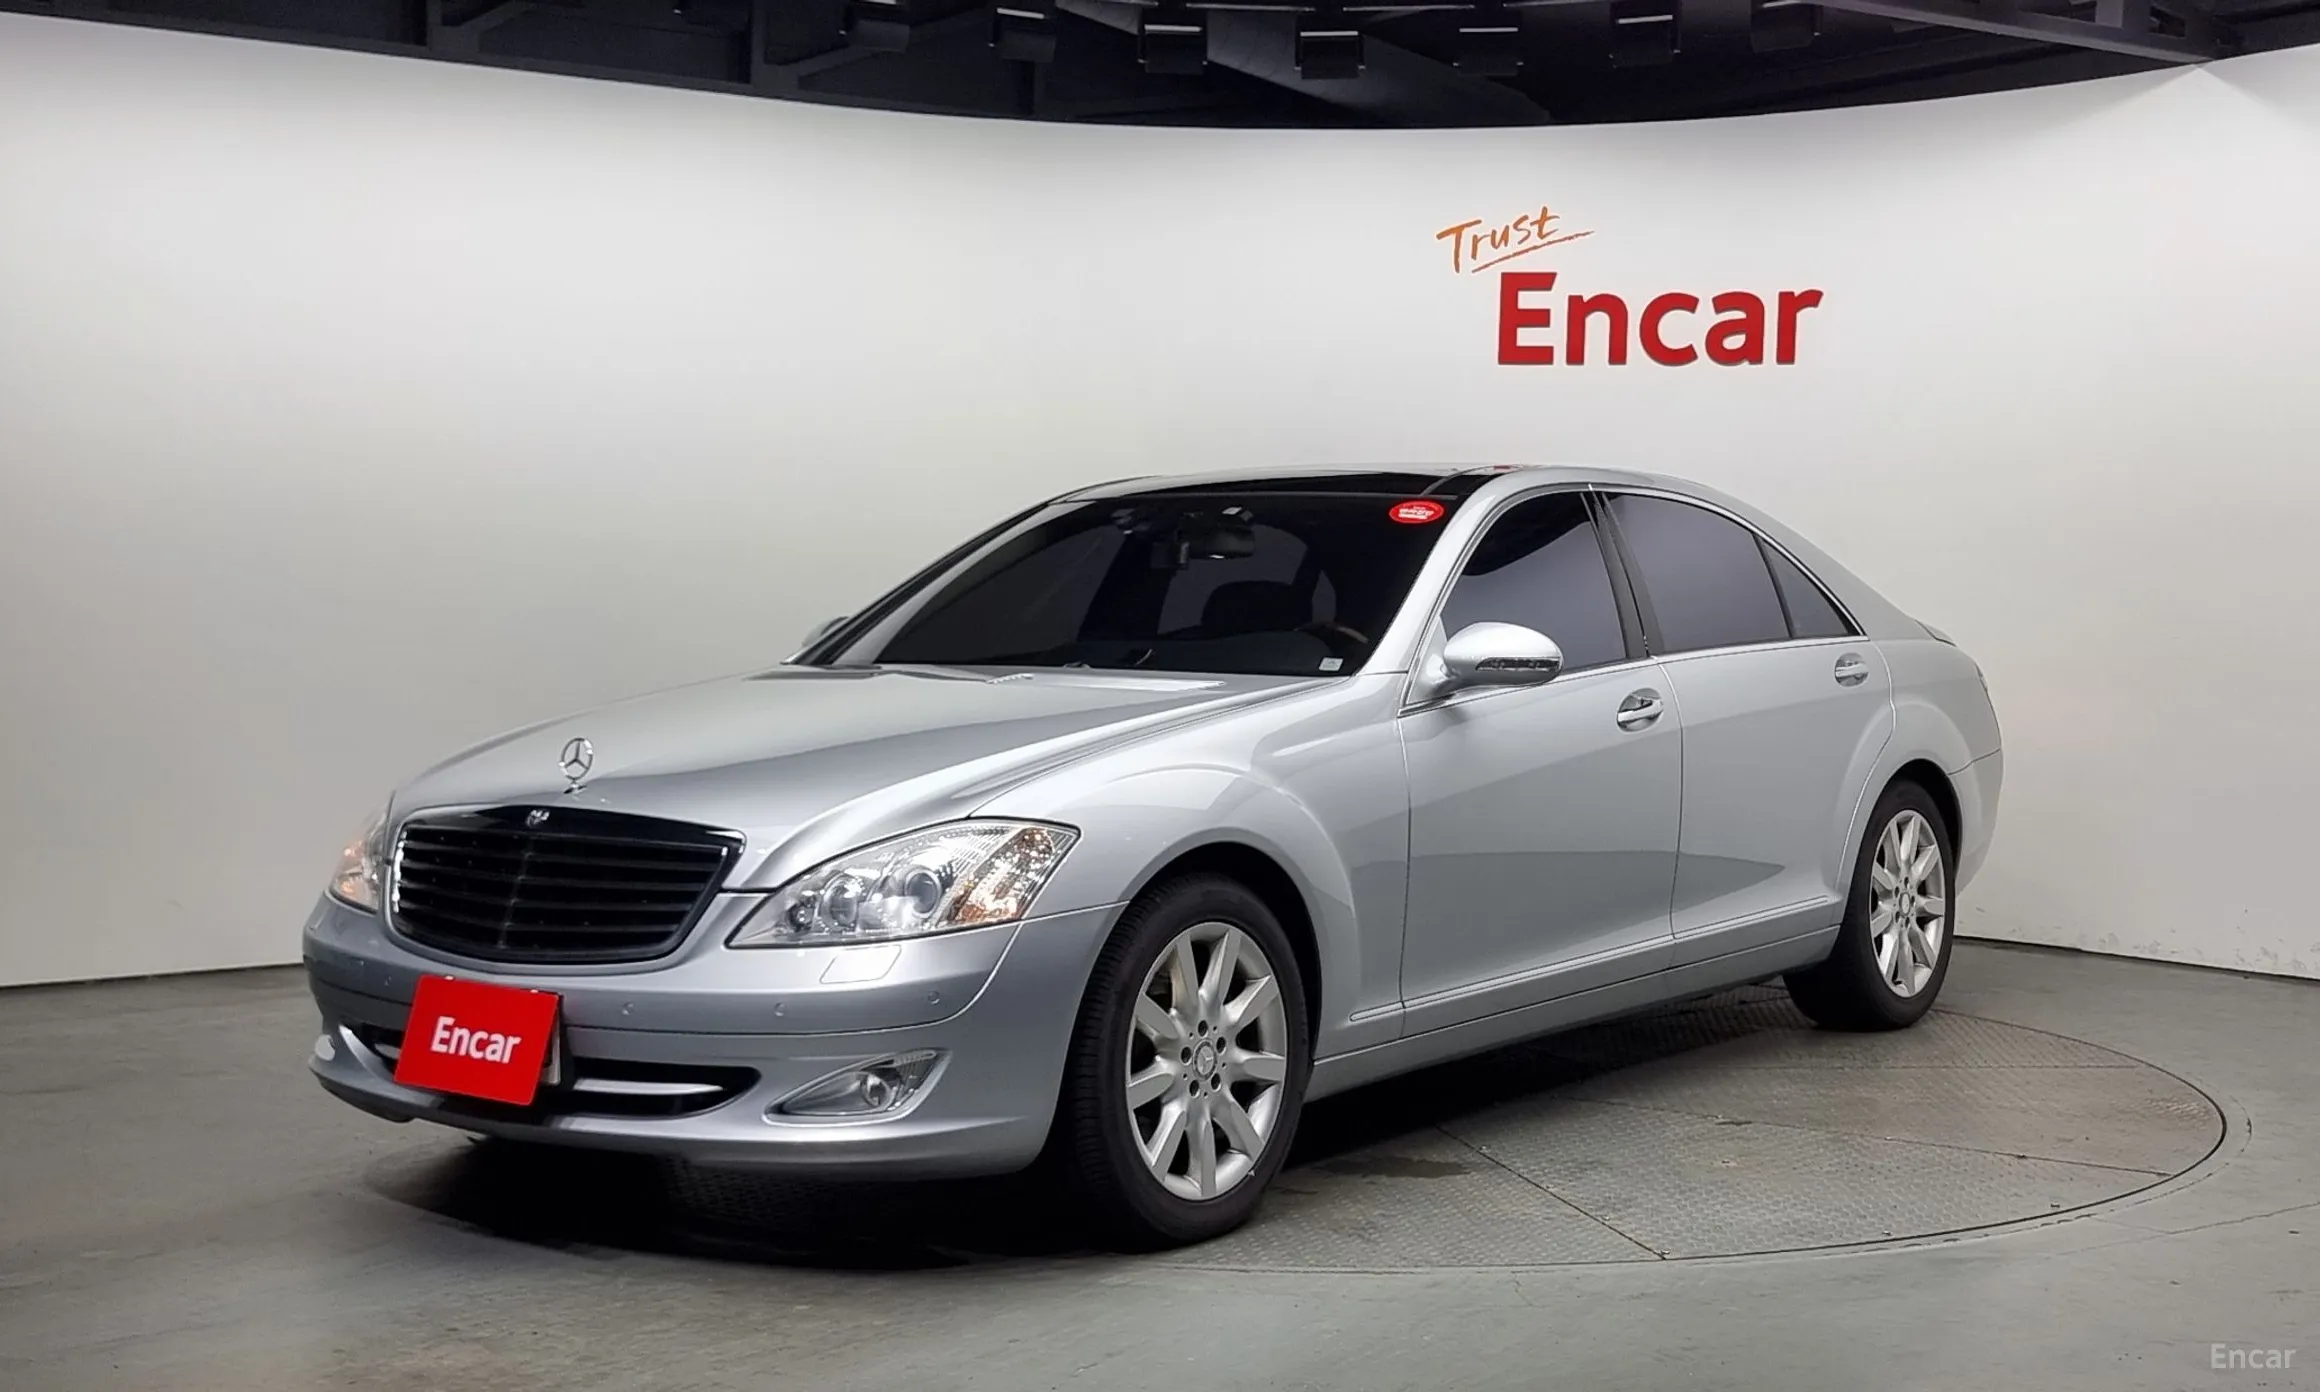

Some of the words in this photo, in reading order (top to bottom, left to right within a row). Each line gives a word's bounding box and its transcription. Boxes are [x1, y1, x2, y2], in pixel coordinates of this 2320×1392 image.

[1436, 206, 1560, 273] Trust
[1498, 272, 1823, 367] Encar
[431, 1016, 521, 1063] Encar
